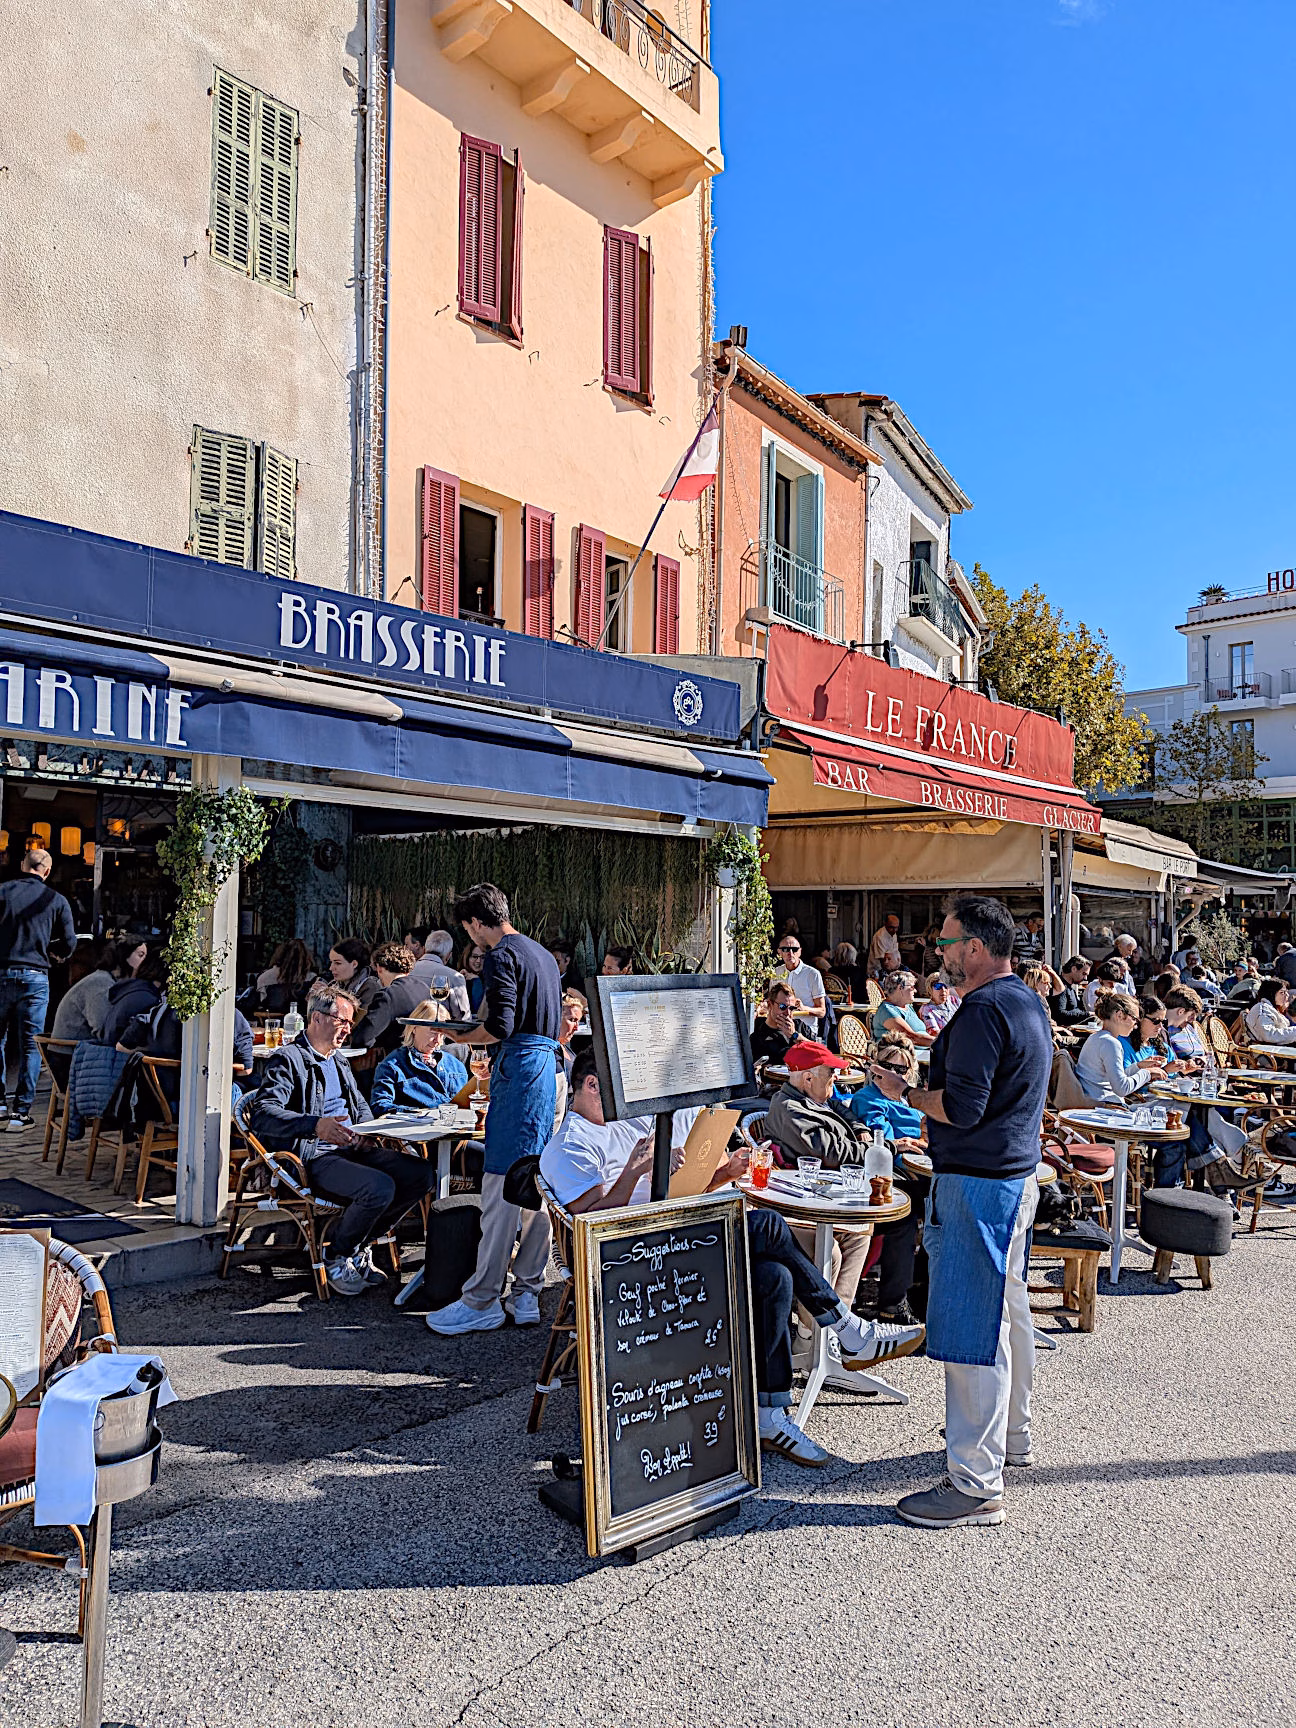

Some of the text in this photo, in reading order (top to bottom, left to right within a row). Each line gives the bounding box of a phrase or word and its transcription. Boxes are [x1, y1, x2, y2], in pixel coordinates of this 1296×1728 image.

[277, 592, 506, 687] BRASSERIE
[864, 690, 1018, 769] LE FRANCE
[826, 761, 1095, 832] BAR BRASSERIE GLACIER
[1163, 857, 1190, 873] BAR LE PORT
[632, 1234, 690, 1271] Suggestions
[612, 1382, 644, 1407] Souris
[648, 1379, 684, 1404] d'agneau
